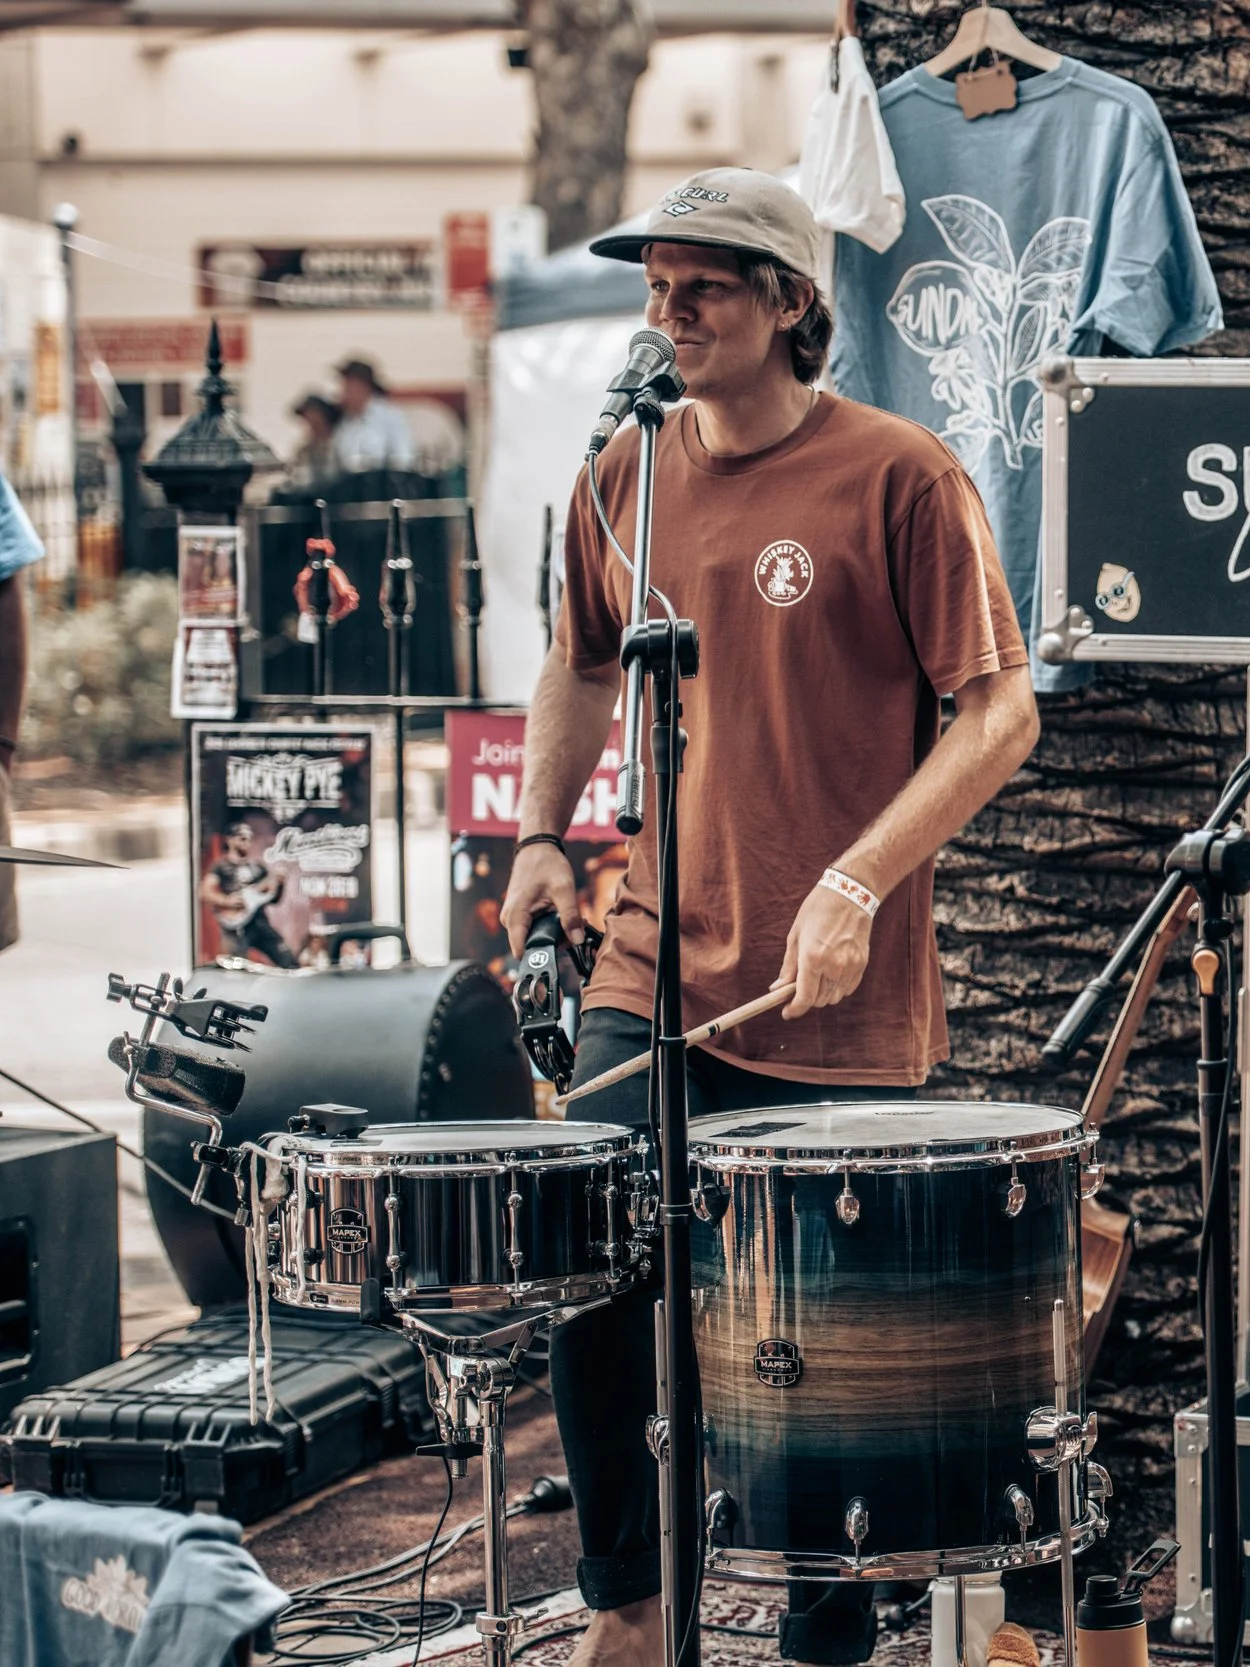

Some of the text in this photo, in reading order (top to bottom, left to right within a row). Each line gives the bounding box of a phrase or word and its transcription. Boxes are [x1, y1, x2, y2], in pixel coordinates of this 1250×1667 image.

[680, 187, 729, 203] CURL
[758, 544, 809, 579] WHISKEY JACK
[226, 760, 343, 800] MICKEY PYE
[332, 1228, 361, 1237] MAPEX
[760, 1360, 792, 1368] MAPEX
